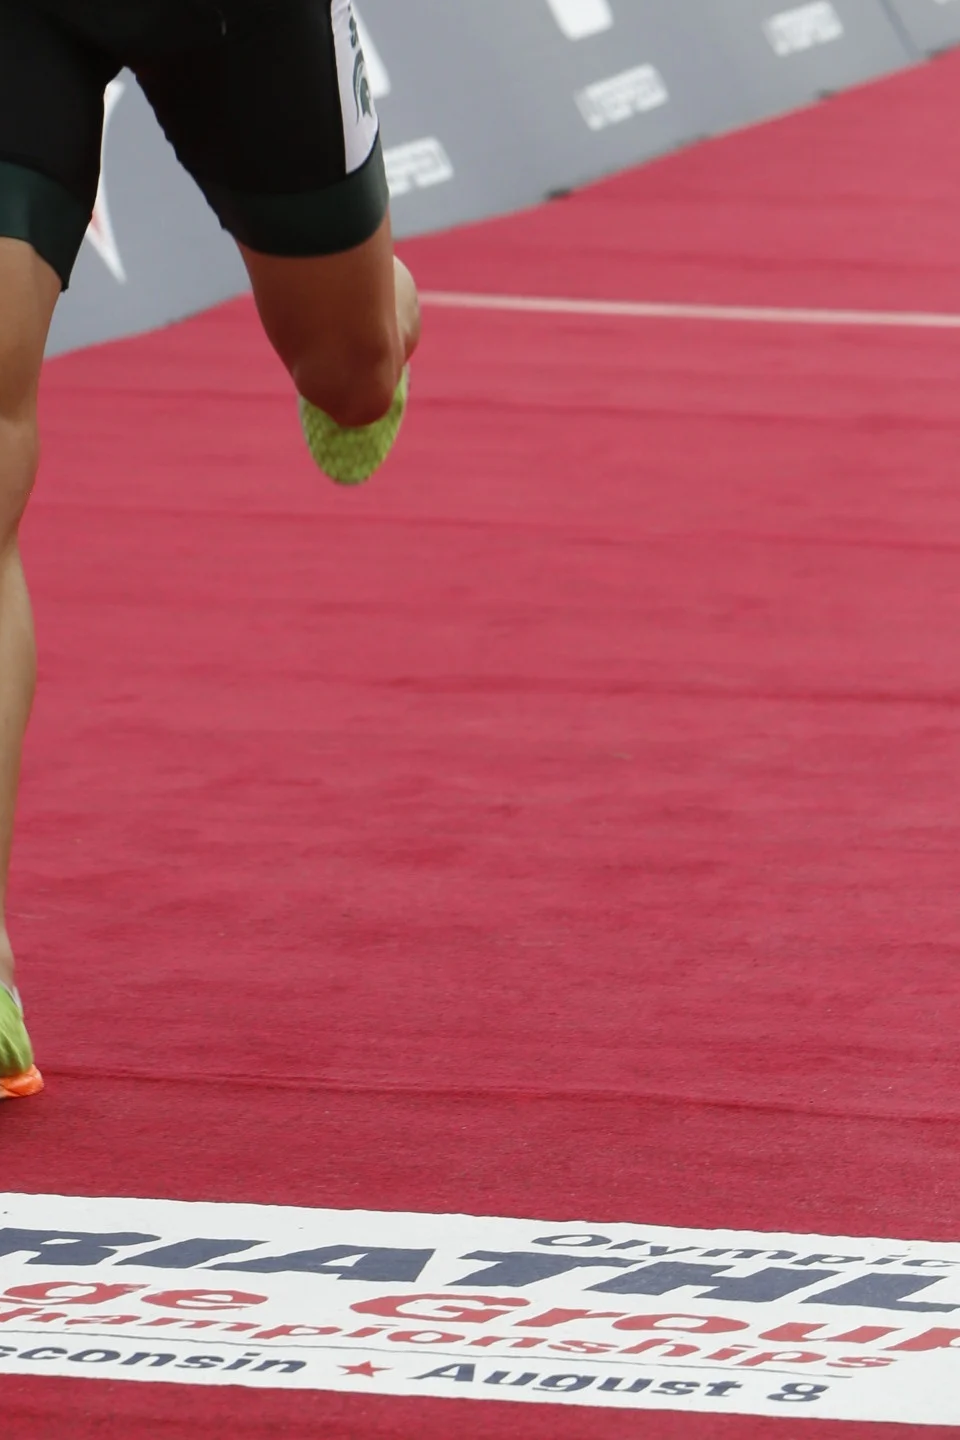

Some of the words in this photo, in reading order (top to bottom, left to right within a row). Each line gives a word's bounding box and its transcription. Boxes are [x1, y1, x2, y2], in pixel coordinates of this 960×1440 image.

[531, 1234, 960, 1267] Olympic
[406, 1363, 743, 1400] August
[767, 1382, 829, 1402] 8
